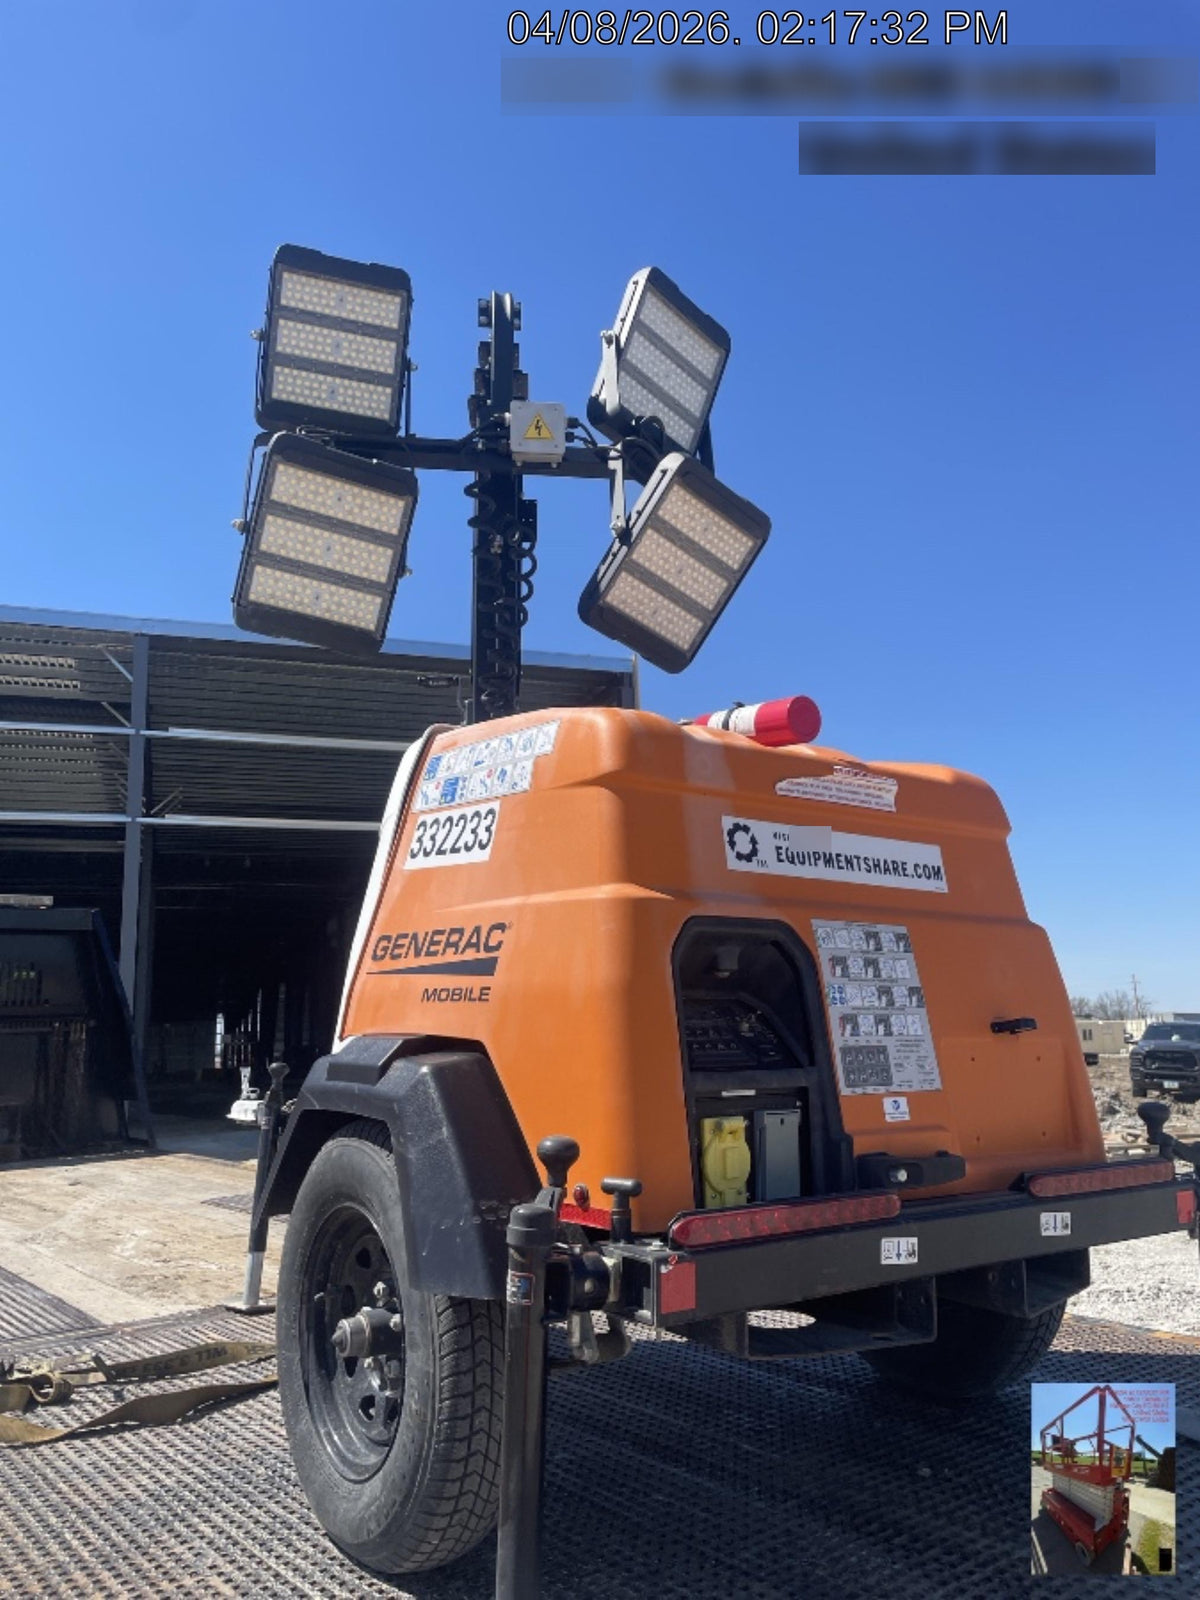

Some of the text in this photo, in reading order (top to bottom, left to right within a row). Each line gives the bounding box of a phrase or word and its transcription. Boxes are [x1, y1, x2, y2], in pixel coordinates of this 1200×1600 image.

[409, 807, 496, 859] 332233
[775, 845, 944, 882] EQUIPMENTSHARE.COM
[371, 922, 507, 962] GENERAC
[421, 986, 491, 1003] MOBILE
